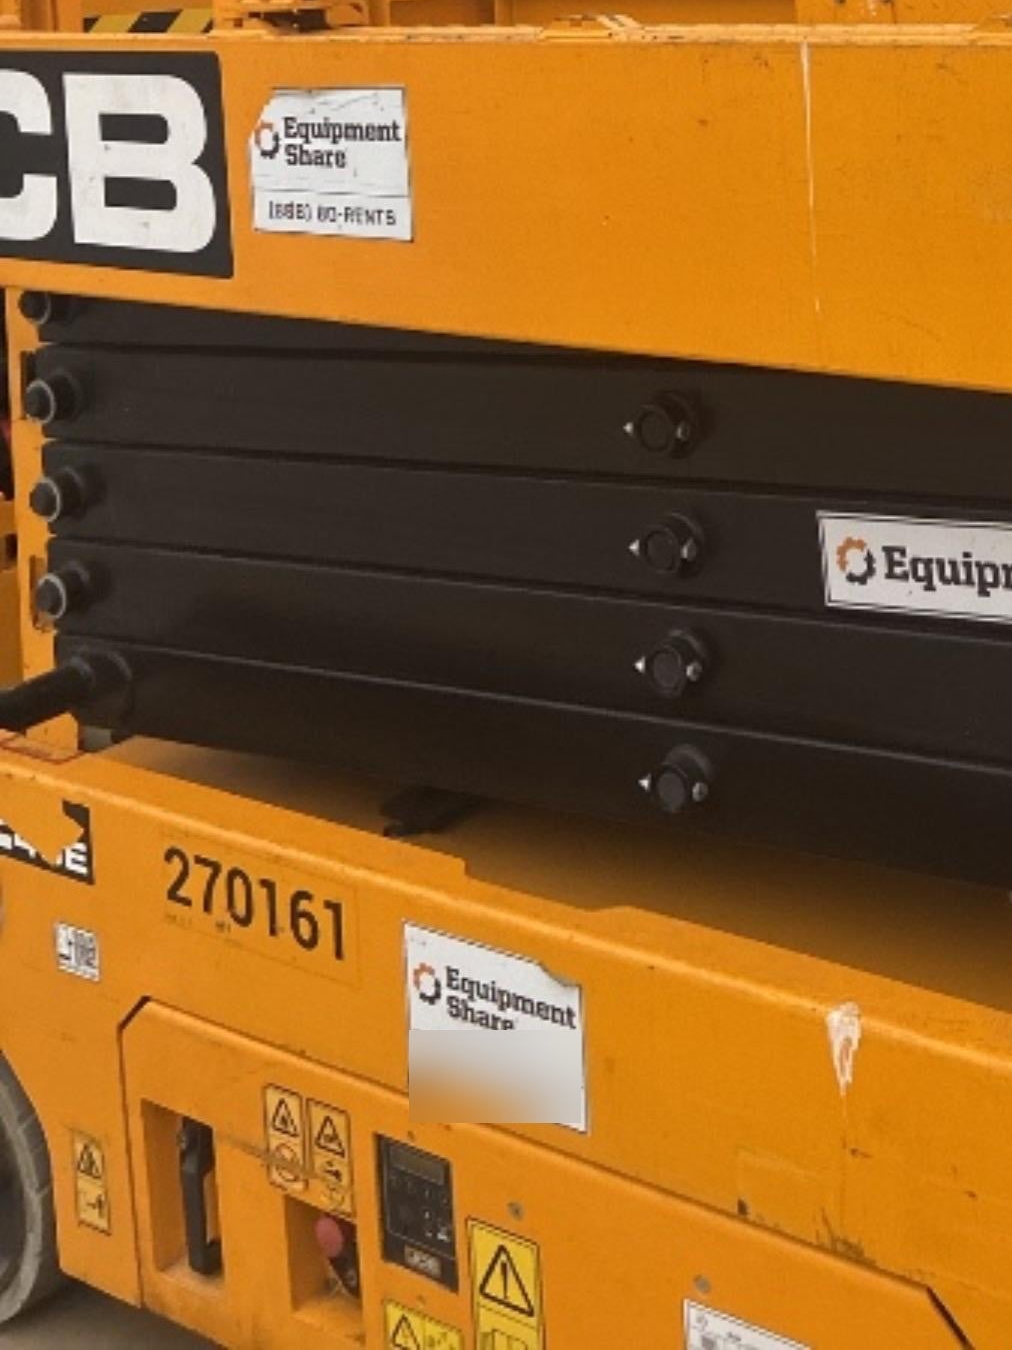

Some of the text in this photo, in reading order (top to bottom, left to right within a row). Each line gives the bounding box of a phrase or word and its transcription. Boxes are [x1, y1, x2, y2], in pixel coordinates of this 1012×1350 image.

[283, 116, 402, 145] Equipment
[285, 143, 346, 168] Share
[163, 846, 343, 961] 270161
[446, 965, 577, 1030] Equipment
[446, 996, 513, 1030] Share
